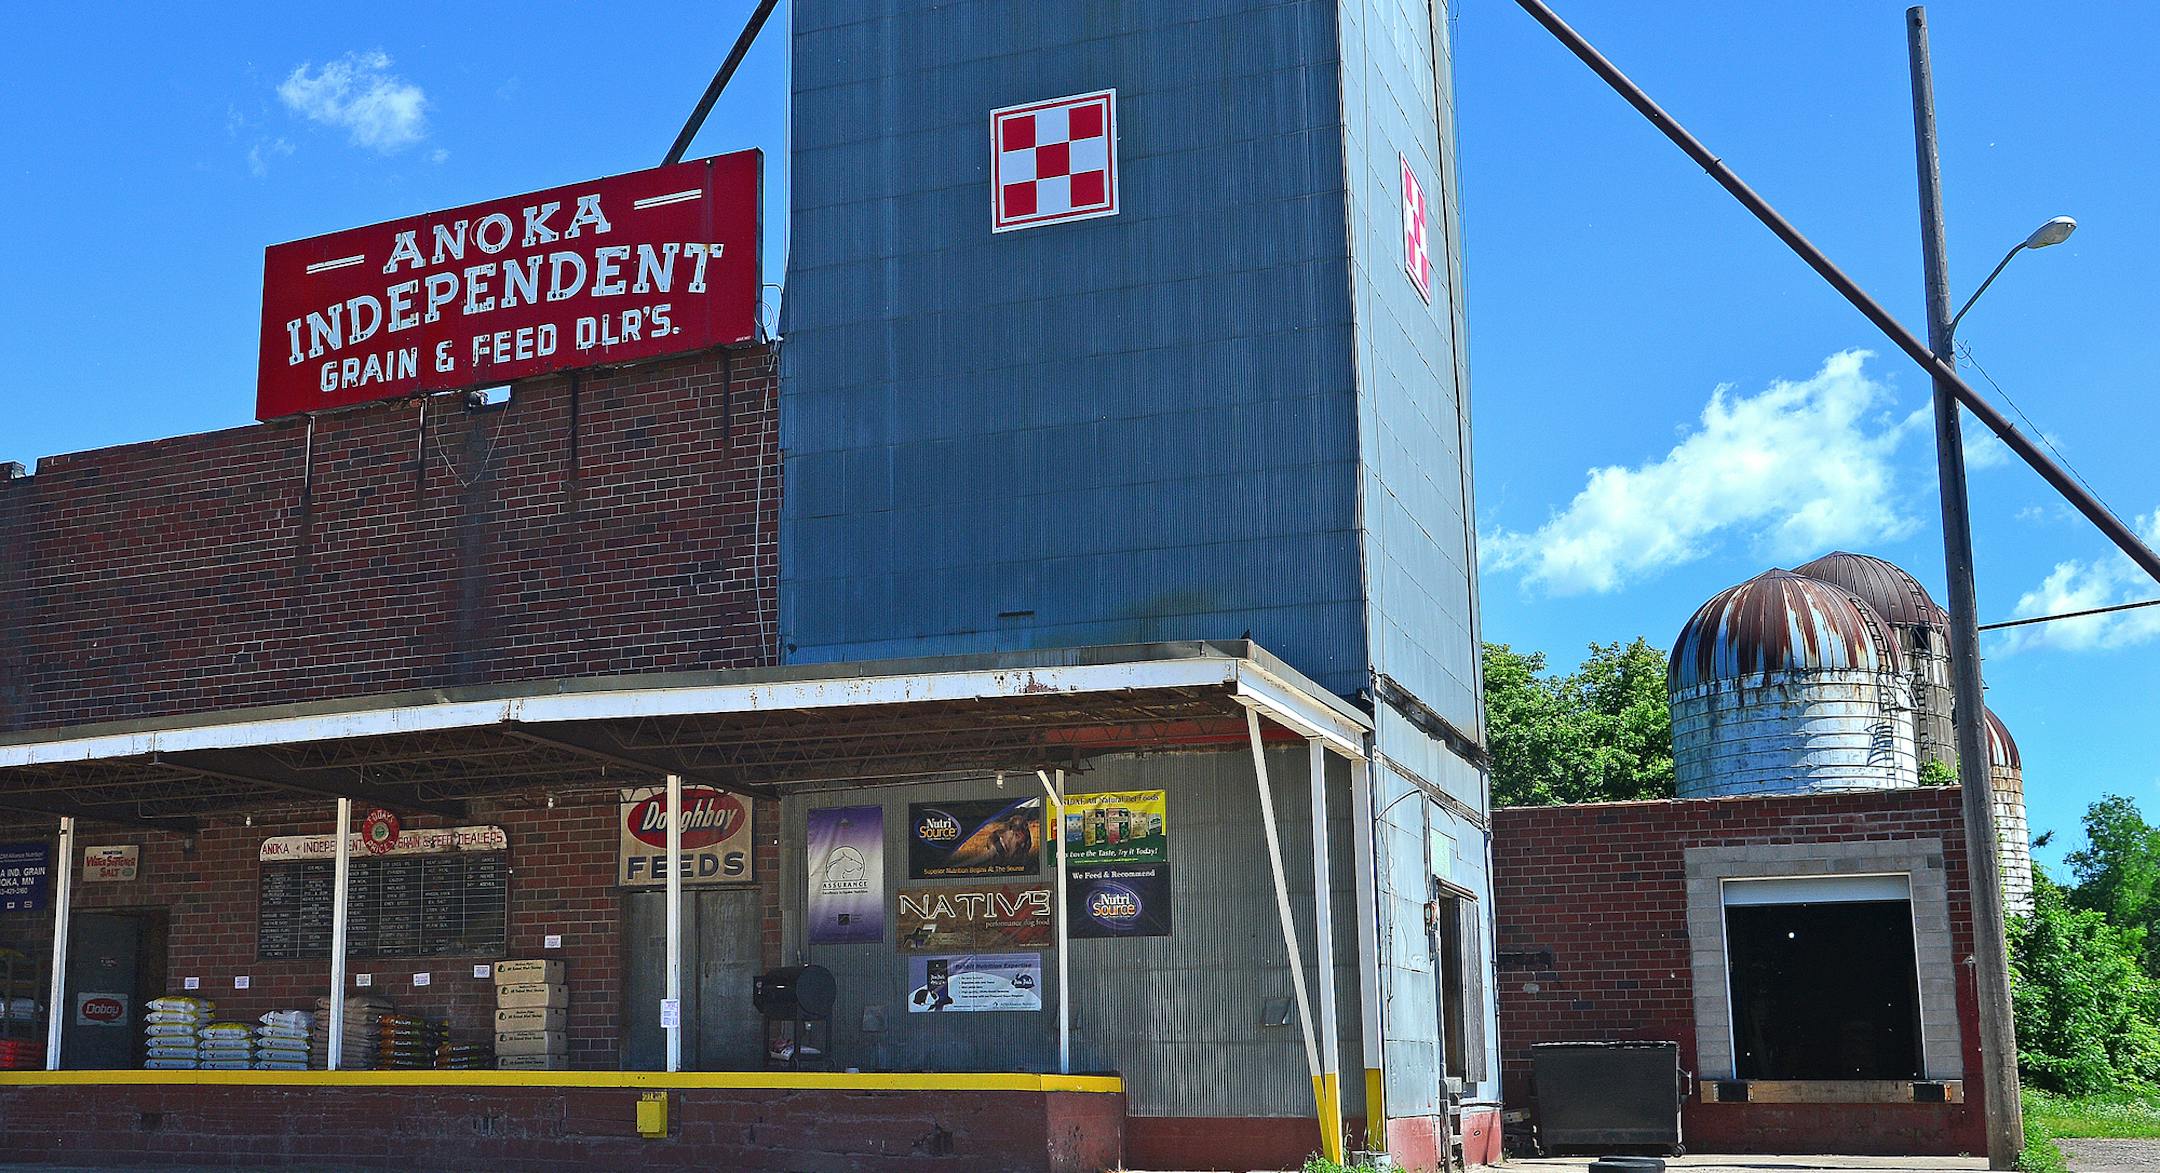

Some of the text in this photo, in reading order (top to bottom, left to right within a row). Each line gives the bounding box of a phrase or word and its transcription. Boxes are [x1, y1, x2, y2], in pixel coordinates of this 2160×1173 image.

[383, 194, 612, 274] ANOKA
[287, 243, 725, 366] INDEPENDENT
[320, 346, 418, 392] GRAIN
[435, 340, 455, 372] &
[473, 323, 557, 367] FEED
[642, 797, 739, 833] Doghboy
[926, 818, 952, 828] Nutri
[919, 826, 957, 839] Source
[261, 842, 290, 855] ANOKA
[303, 838, 363, 854] INDEPEENT
[459, 831, 503, 845] DEALERS
[23, 866, 46, 877] GRAIN
[627, 851, 745, 880] FEEDS
[1085, 871, 1102, 879] Feed
[1103, 870, 1110, 878] &
[1111, 869, 1155, 878] Recommend
[823, 880, 867, 889] ASSURANCE
[1100, 892, 1130, 905] Nutri
[1092, 902, 1136, 917] Source
[86, 1002, 120, 1017] Doboy
